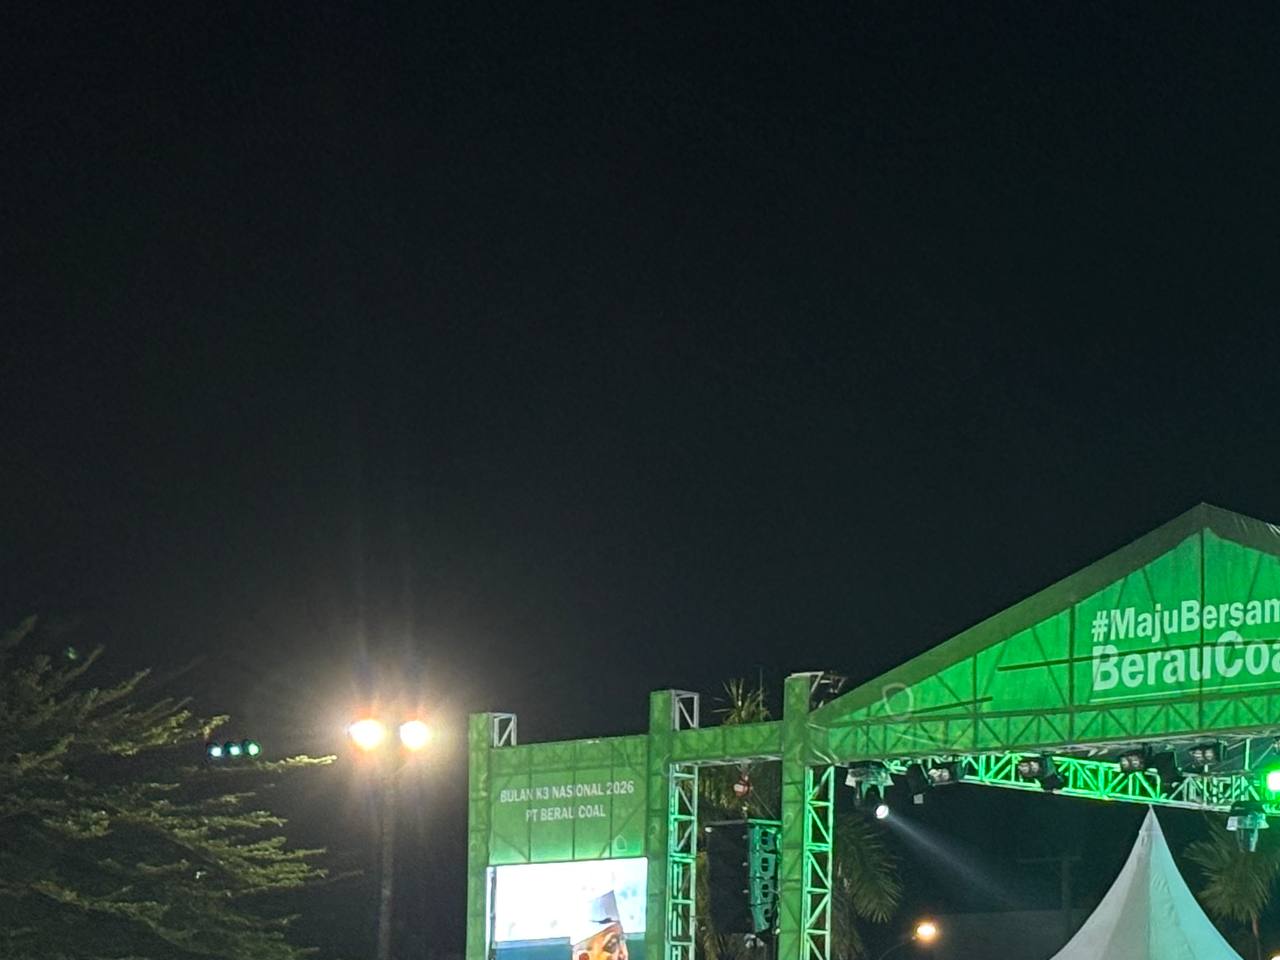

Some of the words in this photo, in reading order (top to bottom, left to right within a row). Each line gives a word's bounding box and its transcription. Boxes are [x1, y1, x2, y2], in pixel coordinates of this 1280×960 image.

[500, 788, 534, 803] BULAN
[535, 786, 549, 800] K3
[606, 780, 634, 795] 2026
[526, 808, 538, 822] PT
[578, 804, 606, 818] COAL
